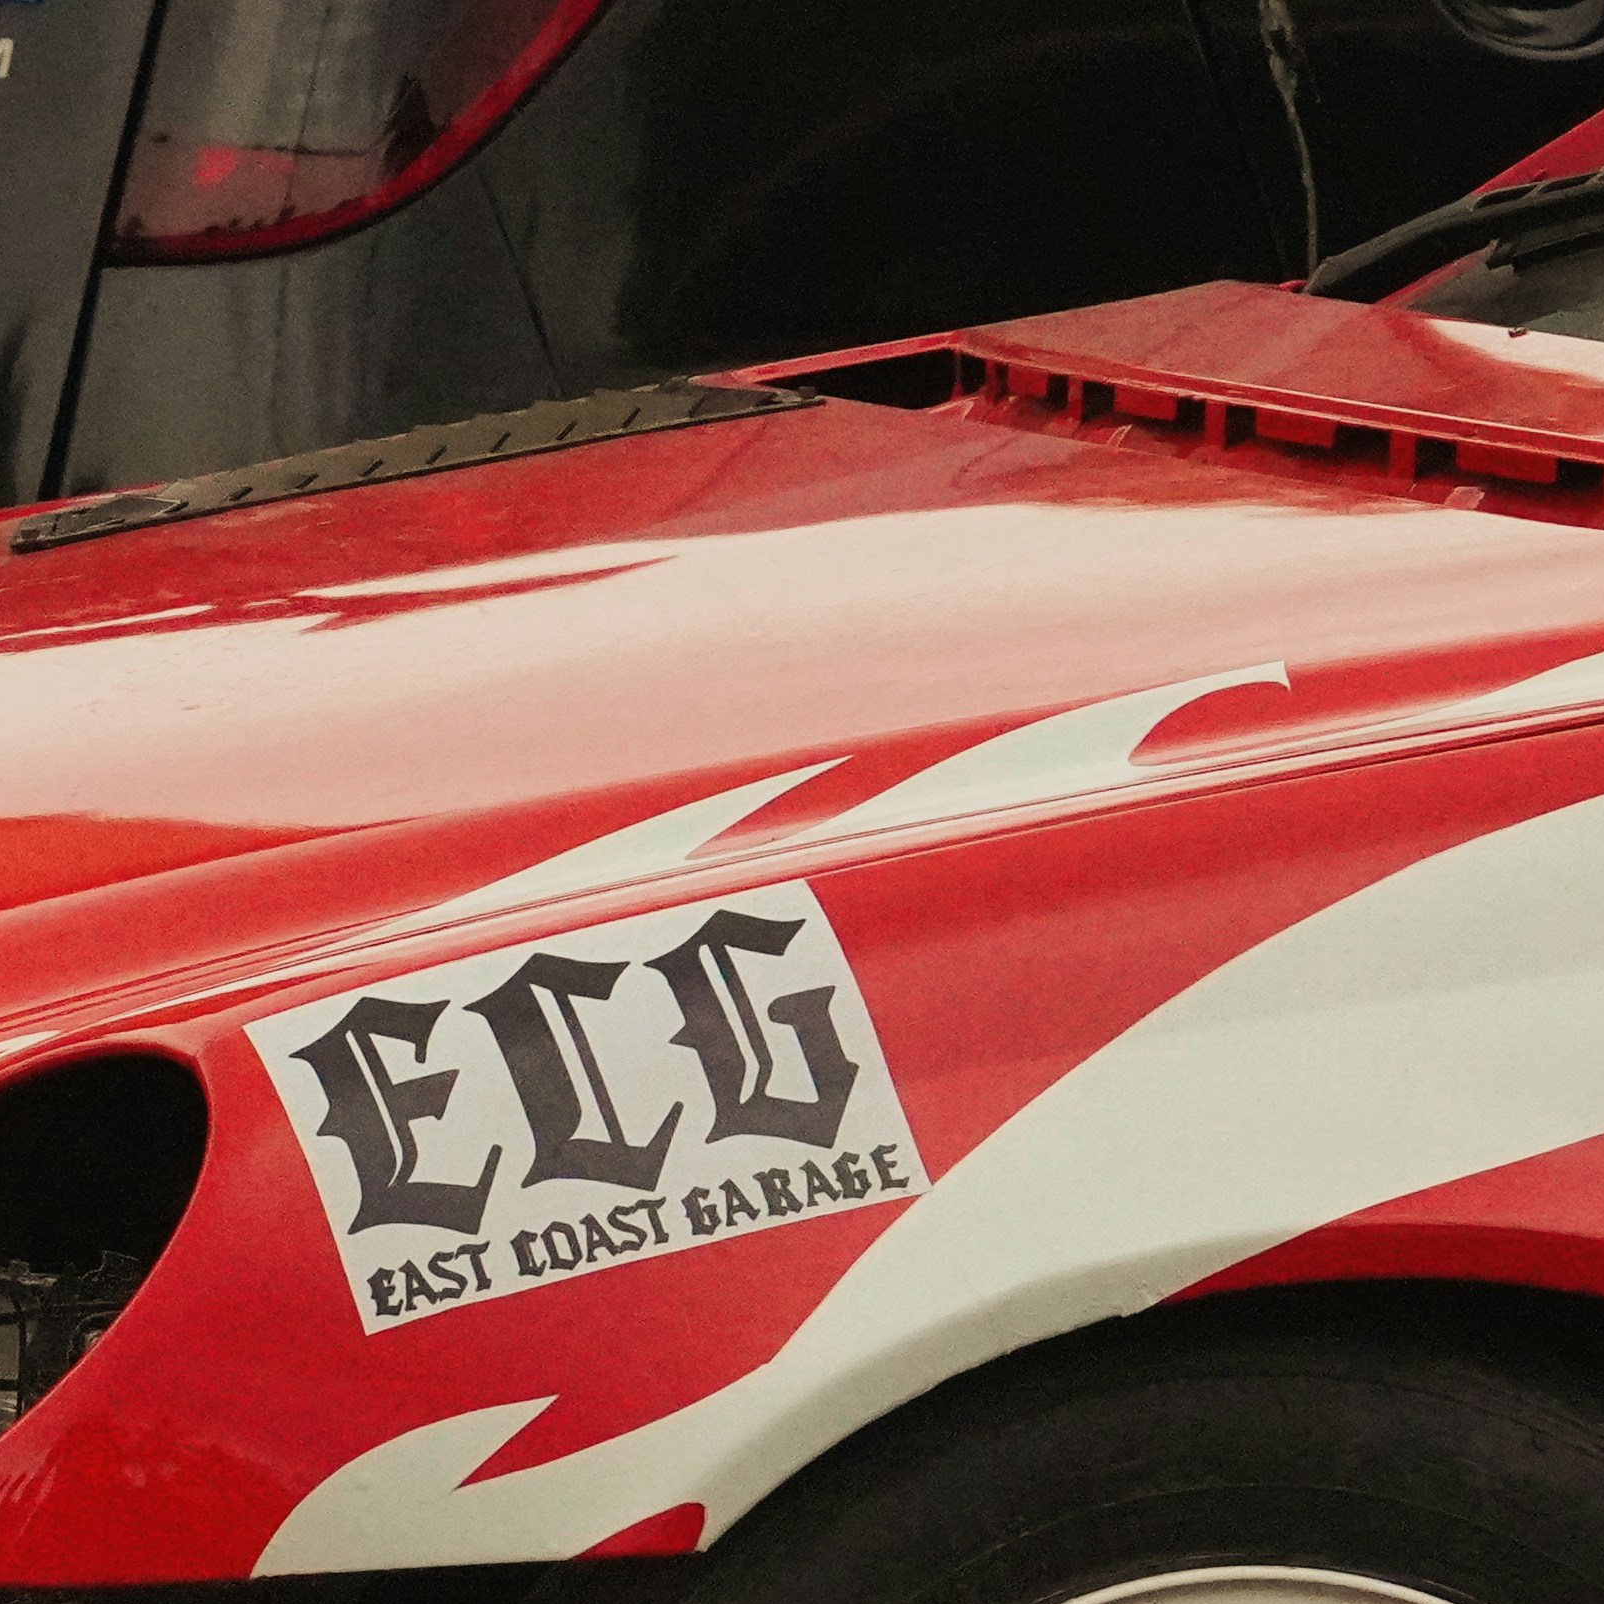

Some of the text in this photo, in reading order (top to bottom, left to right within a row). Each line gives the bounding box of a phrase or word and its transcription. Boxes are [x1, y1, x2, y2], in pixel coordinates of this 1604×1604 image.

[289, 908, 859, 1236] ECG
[367, 1142, 910, 1317] EAST COAST GARAGE
